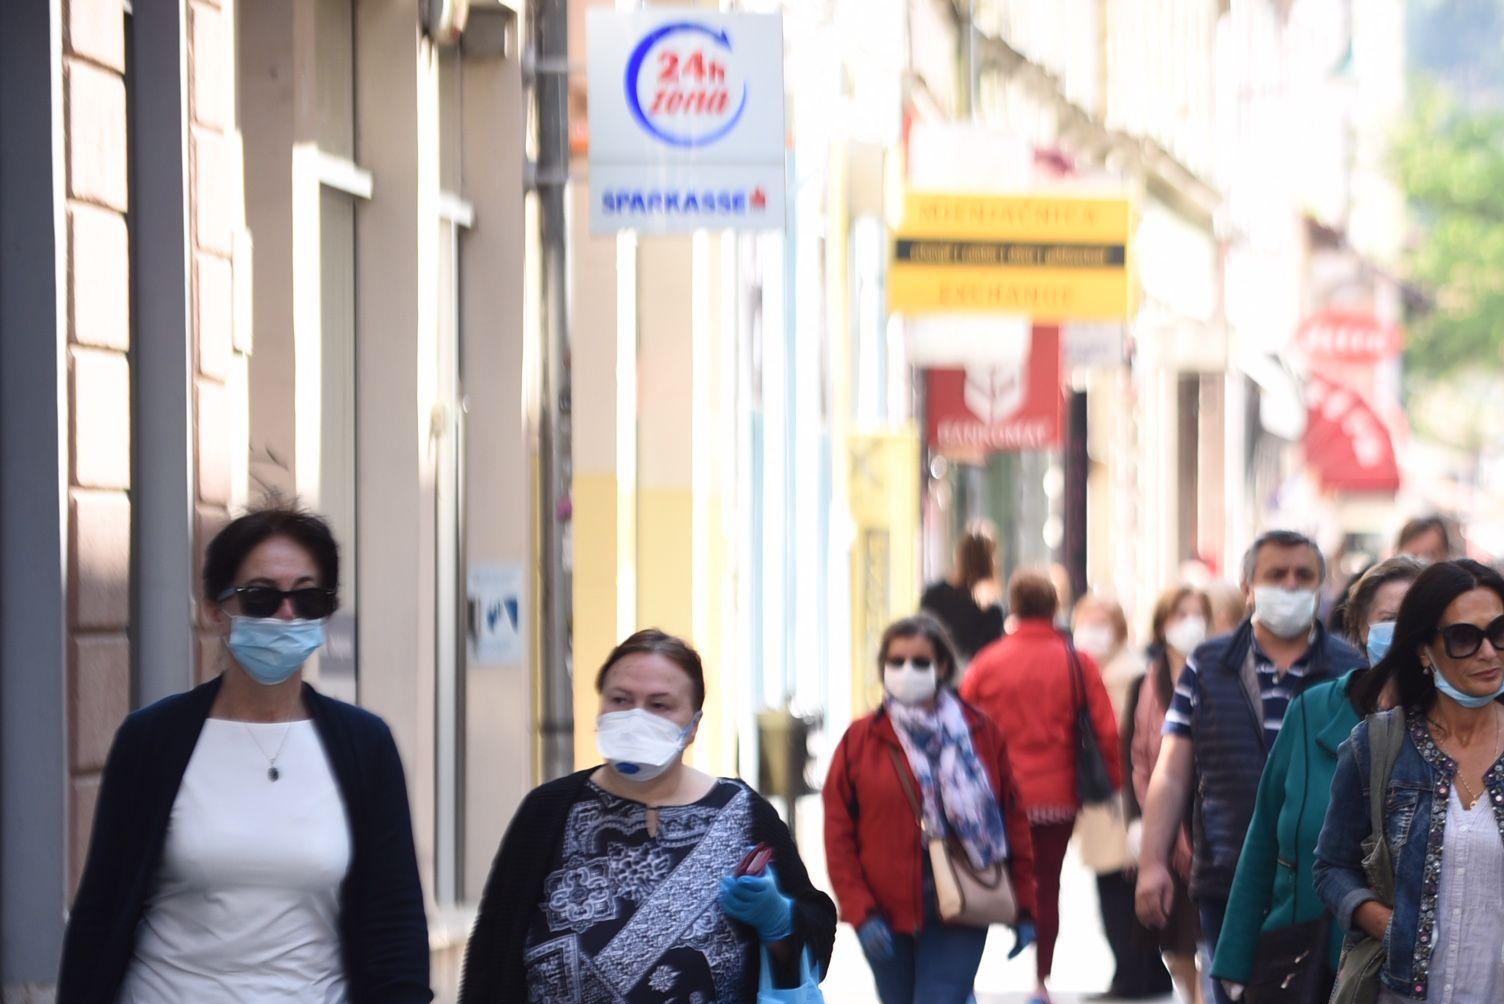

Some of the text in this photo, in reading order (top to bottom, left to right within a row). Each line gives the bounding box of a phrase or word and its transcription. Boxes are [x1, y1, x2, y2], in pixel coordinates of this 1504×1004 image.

[658, 48, 726, 83] 24h
[650, 89, 730, 116] zona
[602, 190, 746, 215] SPARKASSE
[938, 282, 1074, 305] EXCHANGE
[936, 421, 1049, 448] BANKOMAT
